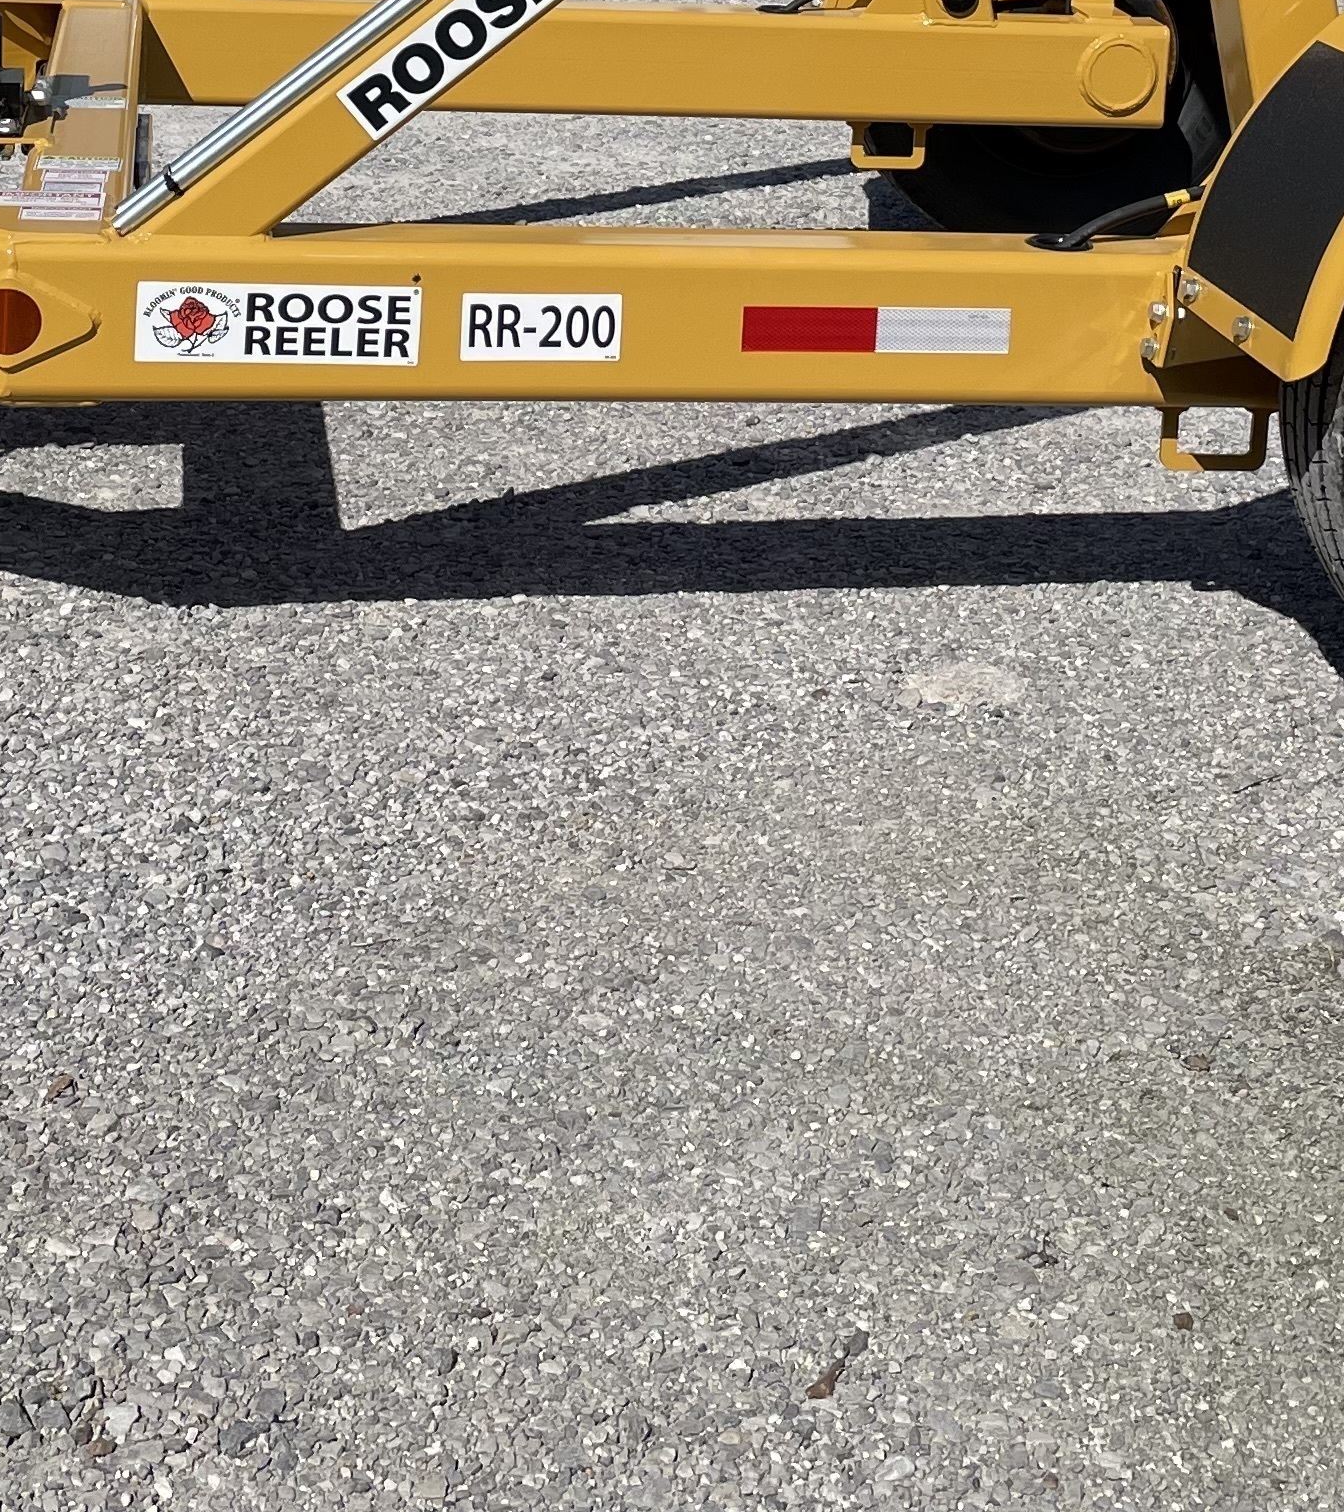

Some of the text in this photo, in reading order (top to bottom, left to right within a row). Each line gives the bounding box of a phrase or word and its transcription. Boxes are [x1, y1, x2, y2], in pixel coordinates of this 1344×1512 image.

[179, 285, 204, 295] GOOD
[205, 287, 242, 318] PRODUCTS
[246, 292, 411, 325] ROOSE
[244, 326, 410, 358] REELER
[468, 303, 616, 349] RR-200
